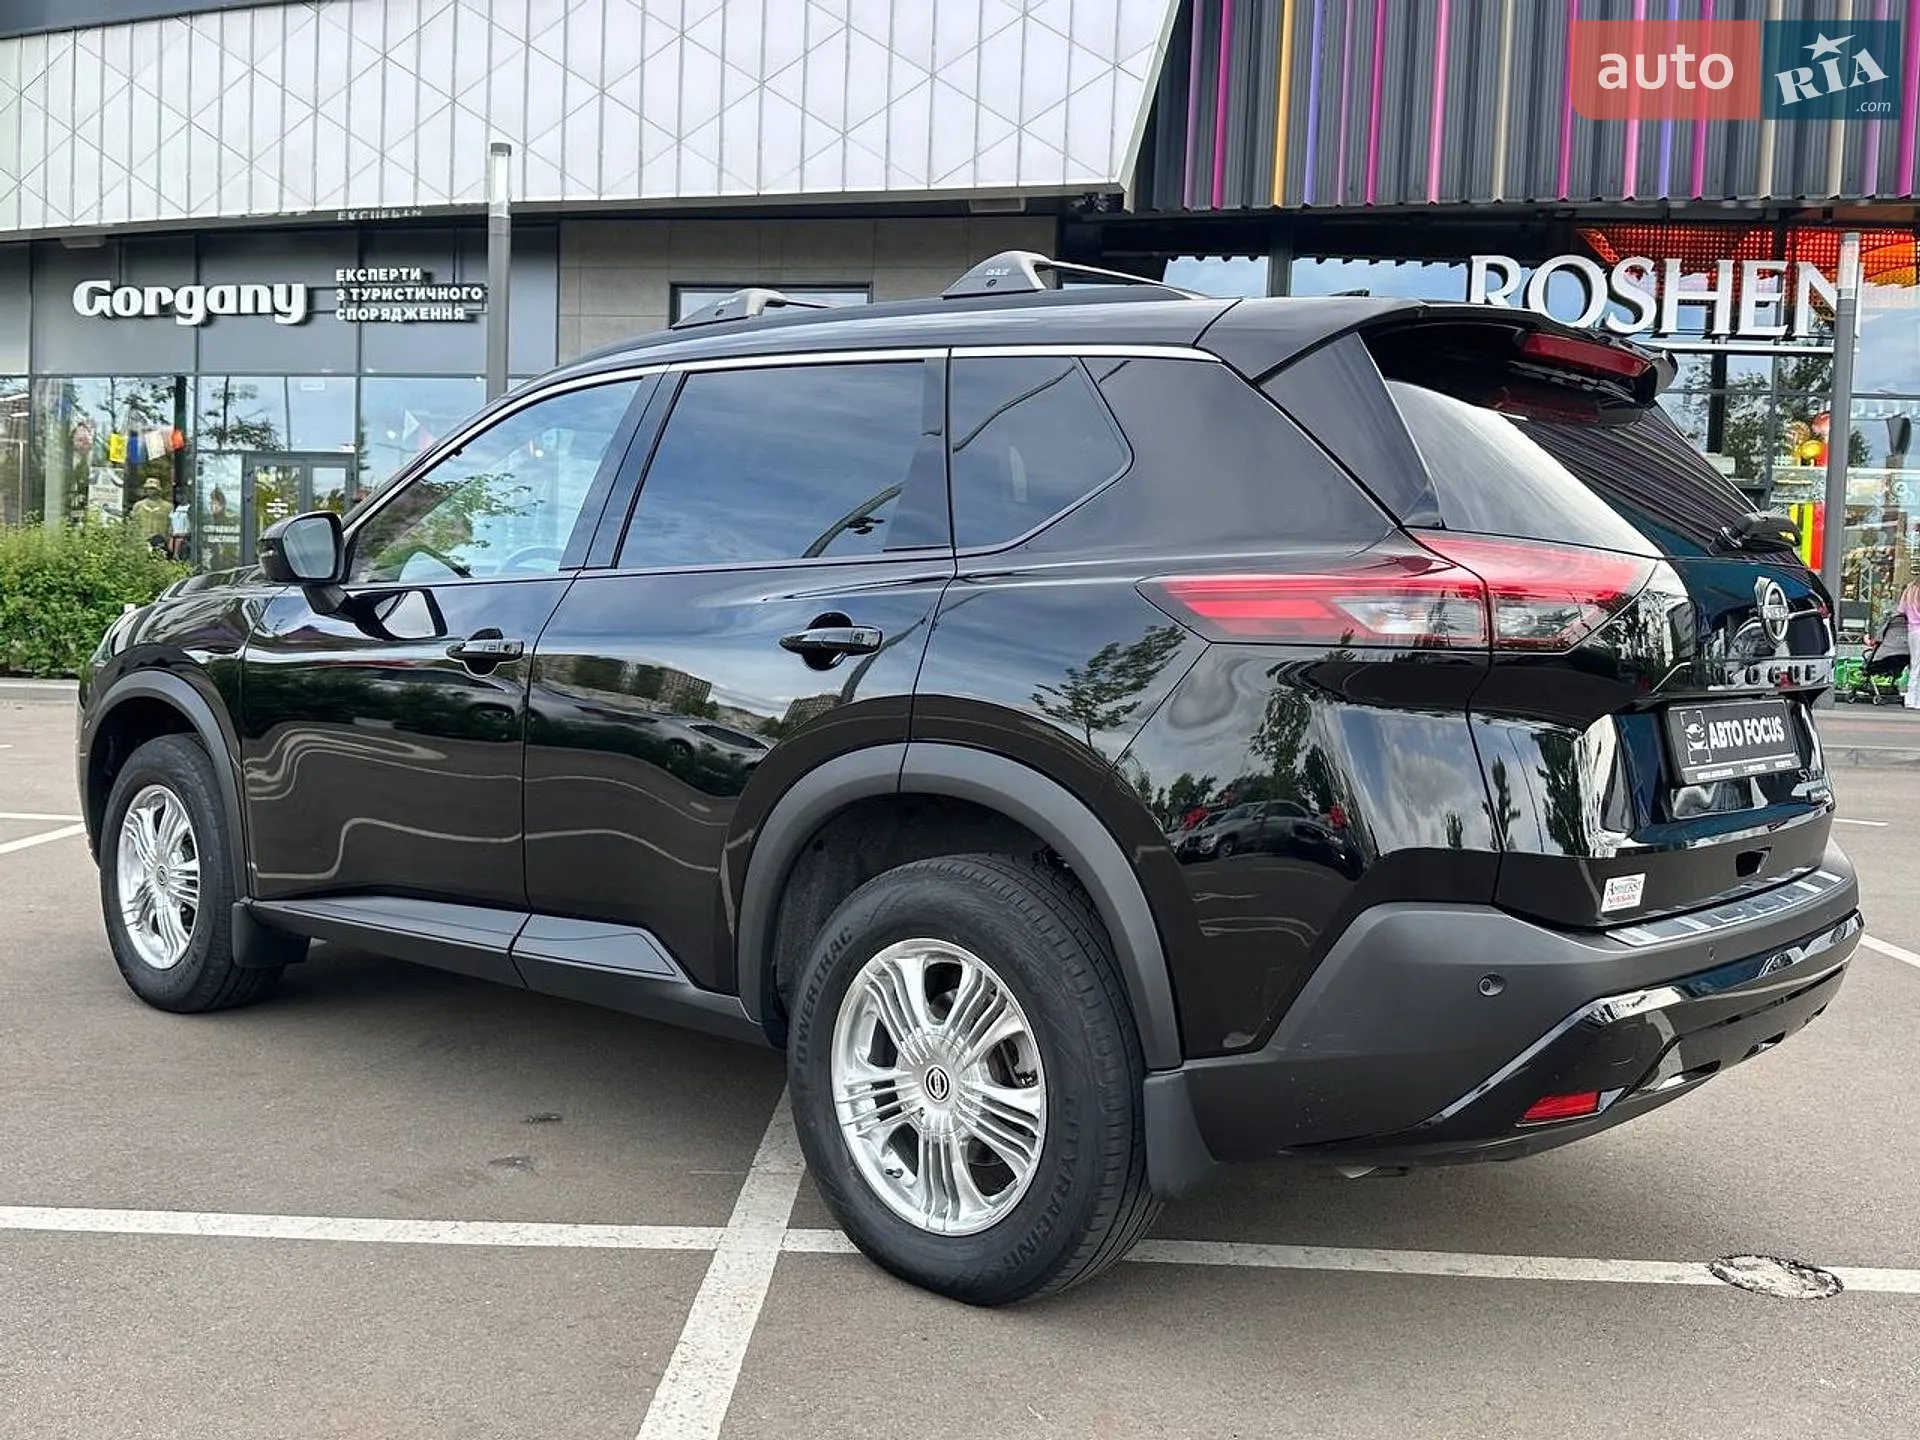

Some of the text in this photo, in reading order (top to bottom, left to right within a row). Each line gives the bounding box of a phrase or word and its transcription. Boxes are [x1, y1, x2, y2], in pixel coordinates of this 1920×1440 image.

[335, 268, 422, 282] ЕКСПЕРТИ
[72, 279, 309, 326] Gorgany
[350, 286, 483, 301] ТУРИСТИЧНОГО
[1470, 254, 1864, 339] ROSHEN
[335, 306, 466, 322] СПОРЯДЖЕННЯ
[1745, 716, 1785, 746] FOCUS
